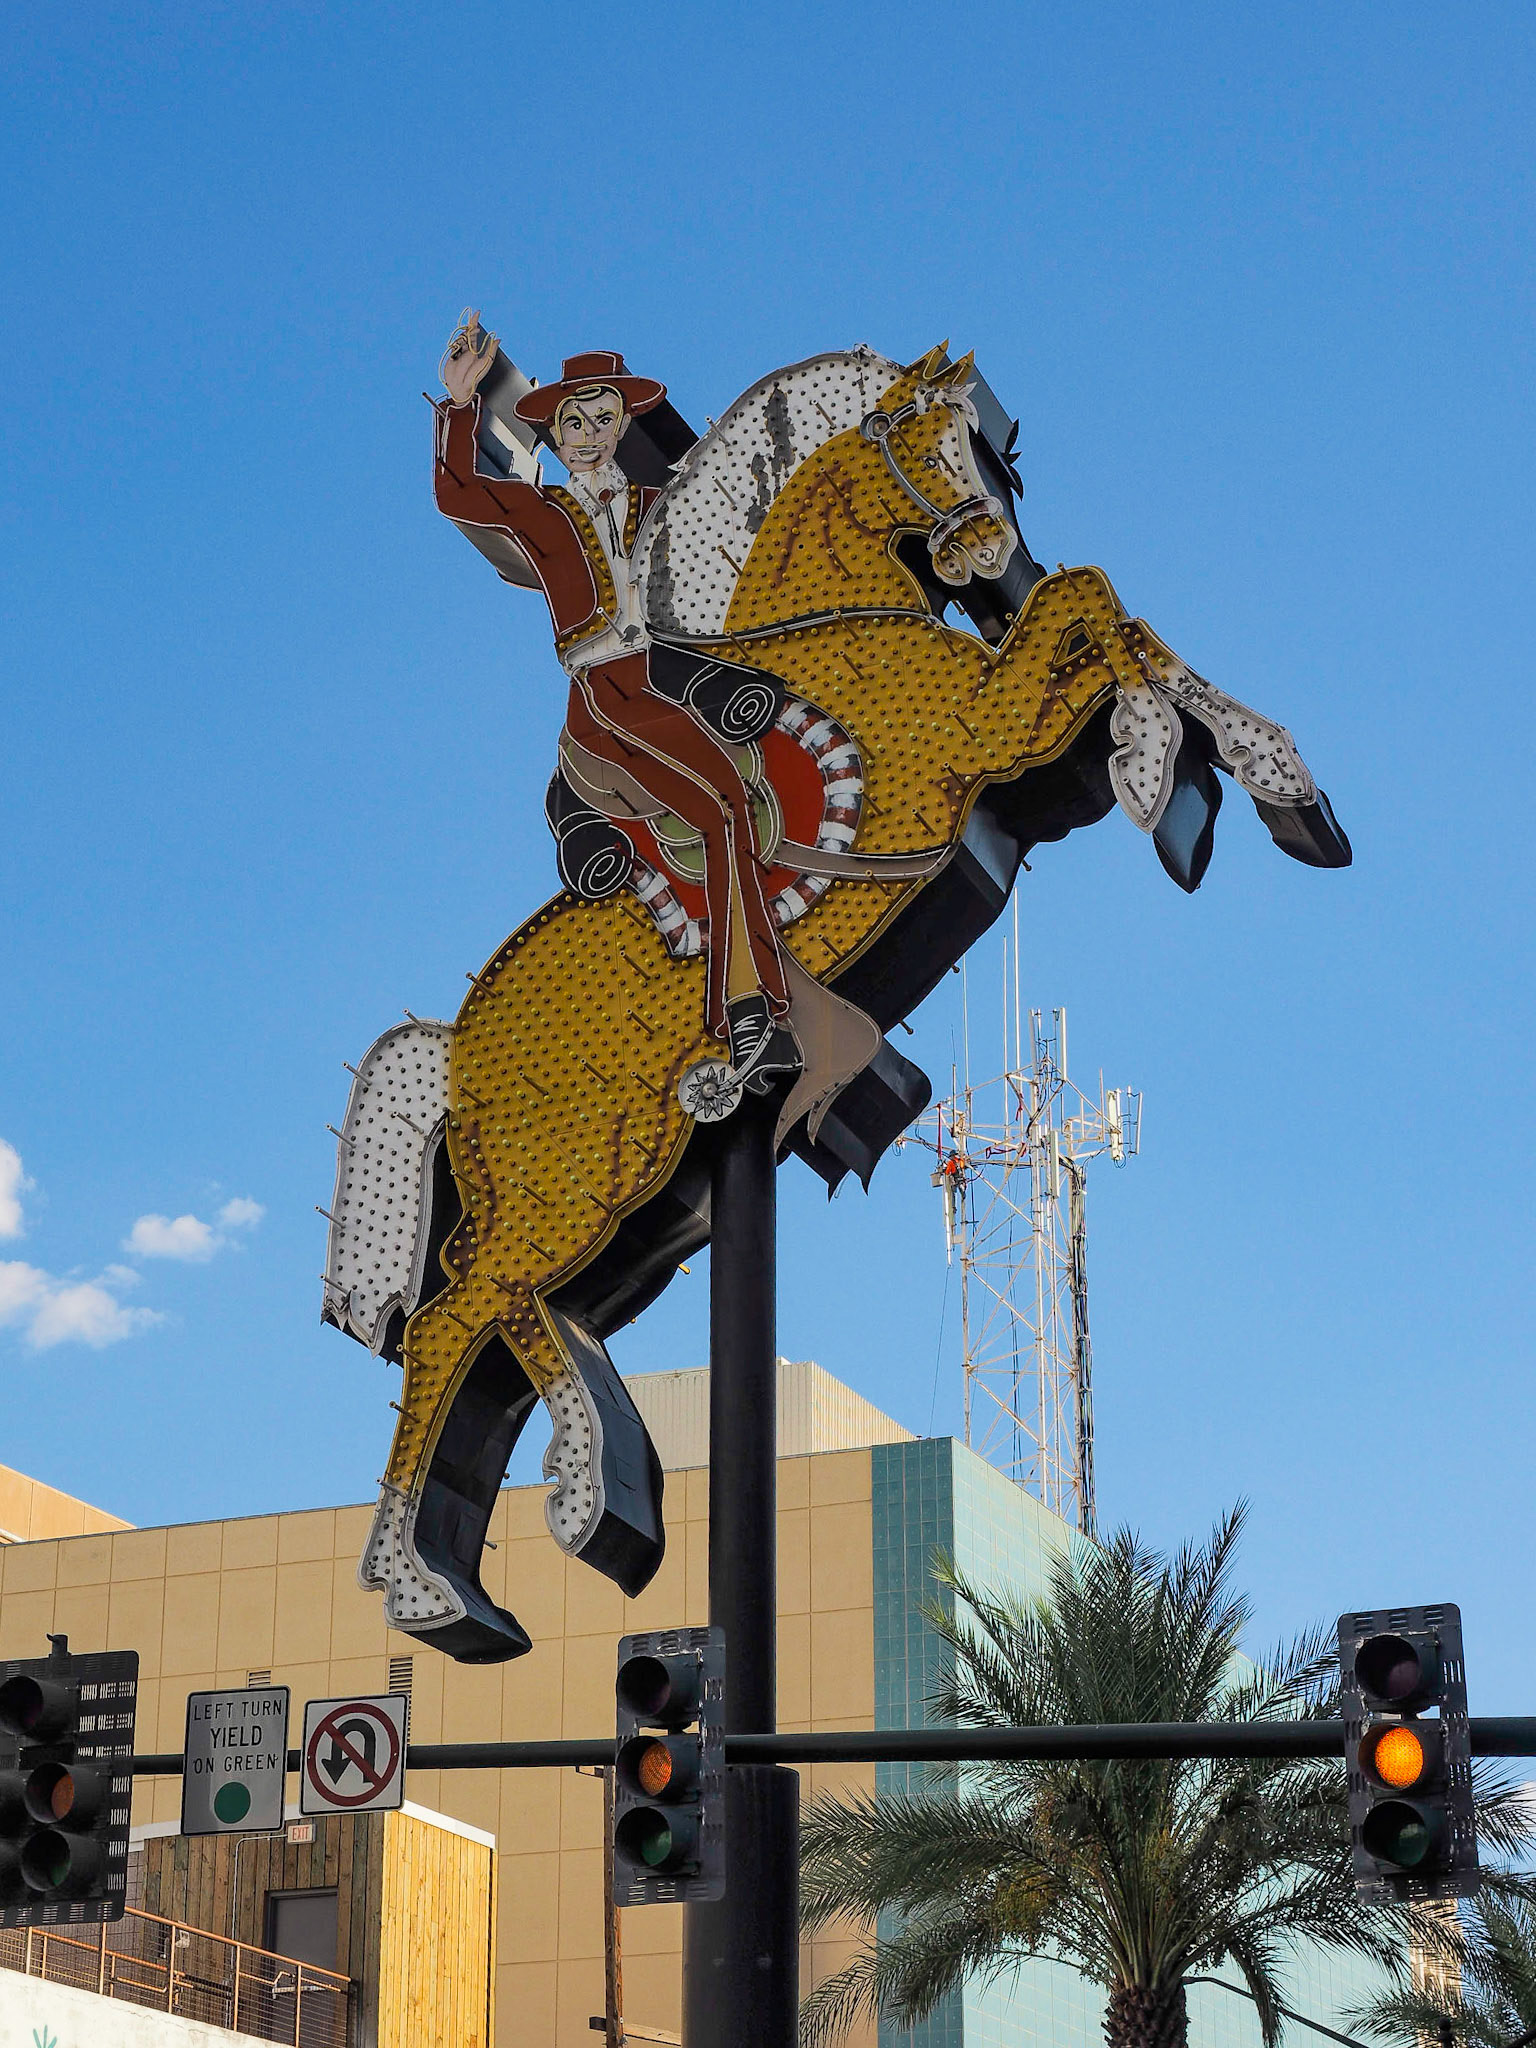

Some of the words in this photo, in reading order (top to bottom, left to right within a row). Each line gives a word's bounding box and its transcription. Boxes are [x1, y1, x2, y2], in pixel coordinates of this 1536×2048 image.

[194, 1702, 234, 1720] LEFT
[242, 1700, 282, 1718] TURN
[210, 1725, 262, 1749] YIELD
[194, 1757, 214, 1774] ON
[224, 1753, 276, 1772] GREEN
[292, 1826, 309, 1841] EXIT
